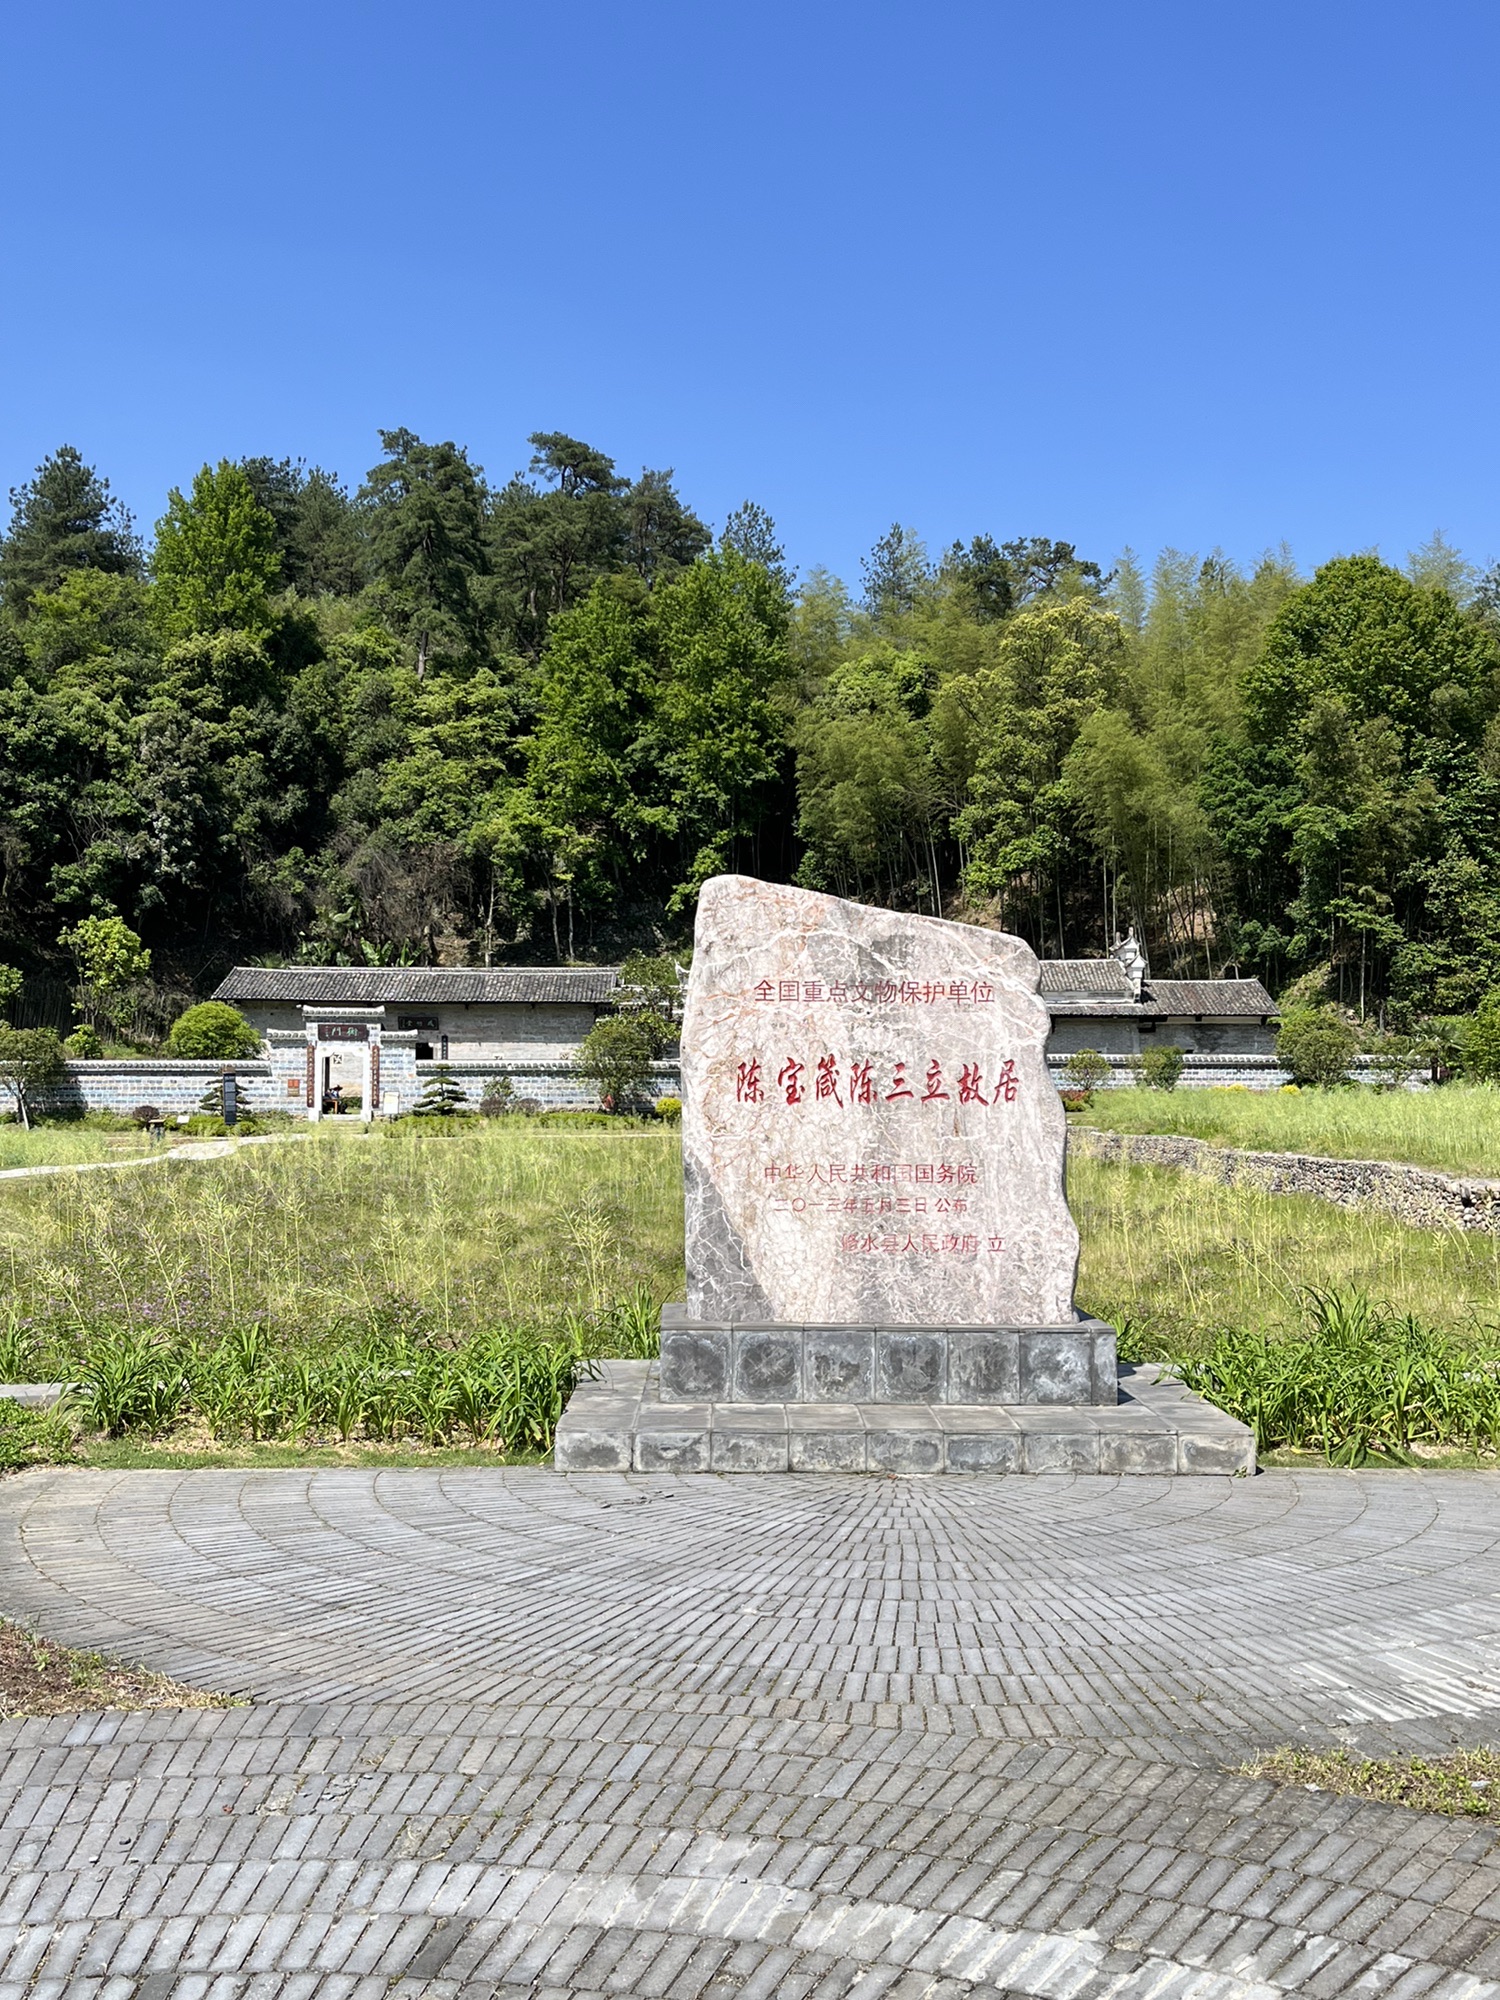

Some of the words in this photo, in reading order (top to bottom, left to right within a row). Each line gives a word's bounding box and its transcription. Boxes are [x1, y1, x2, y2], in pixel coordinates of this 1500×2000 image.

[754, 979, 995, 1004] 全国重点文物保护单位
[736, 1053, 1020, 1108] 陈宝箴陈三立故居
[764, 1163, 978, 1184] 中华人民共和国国务院
